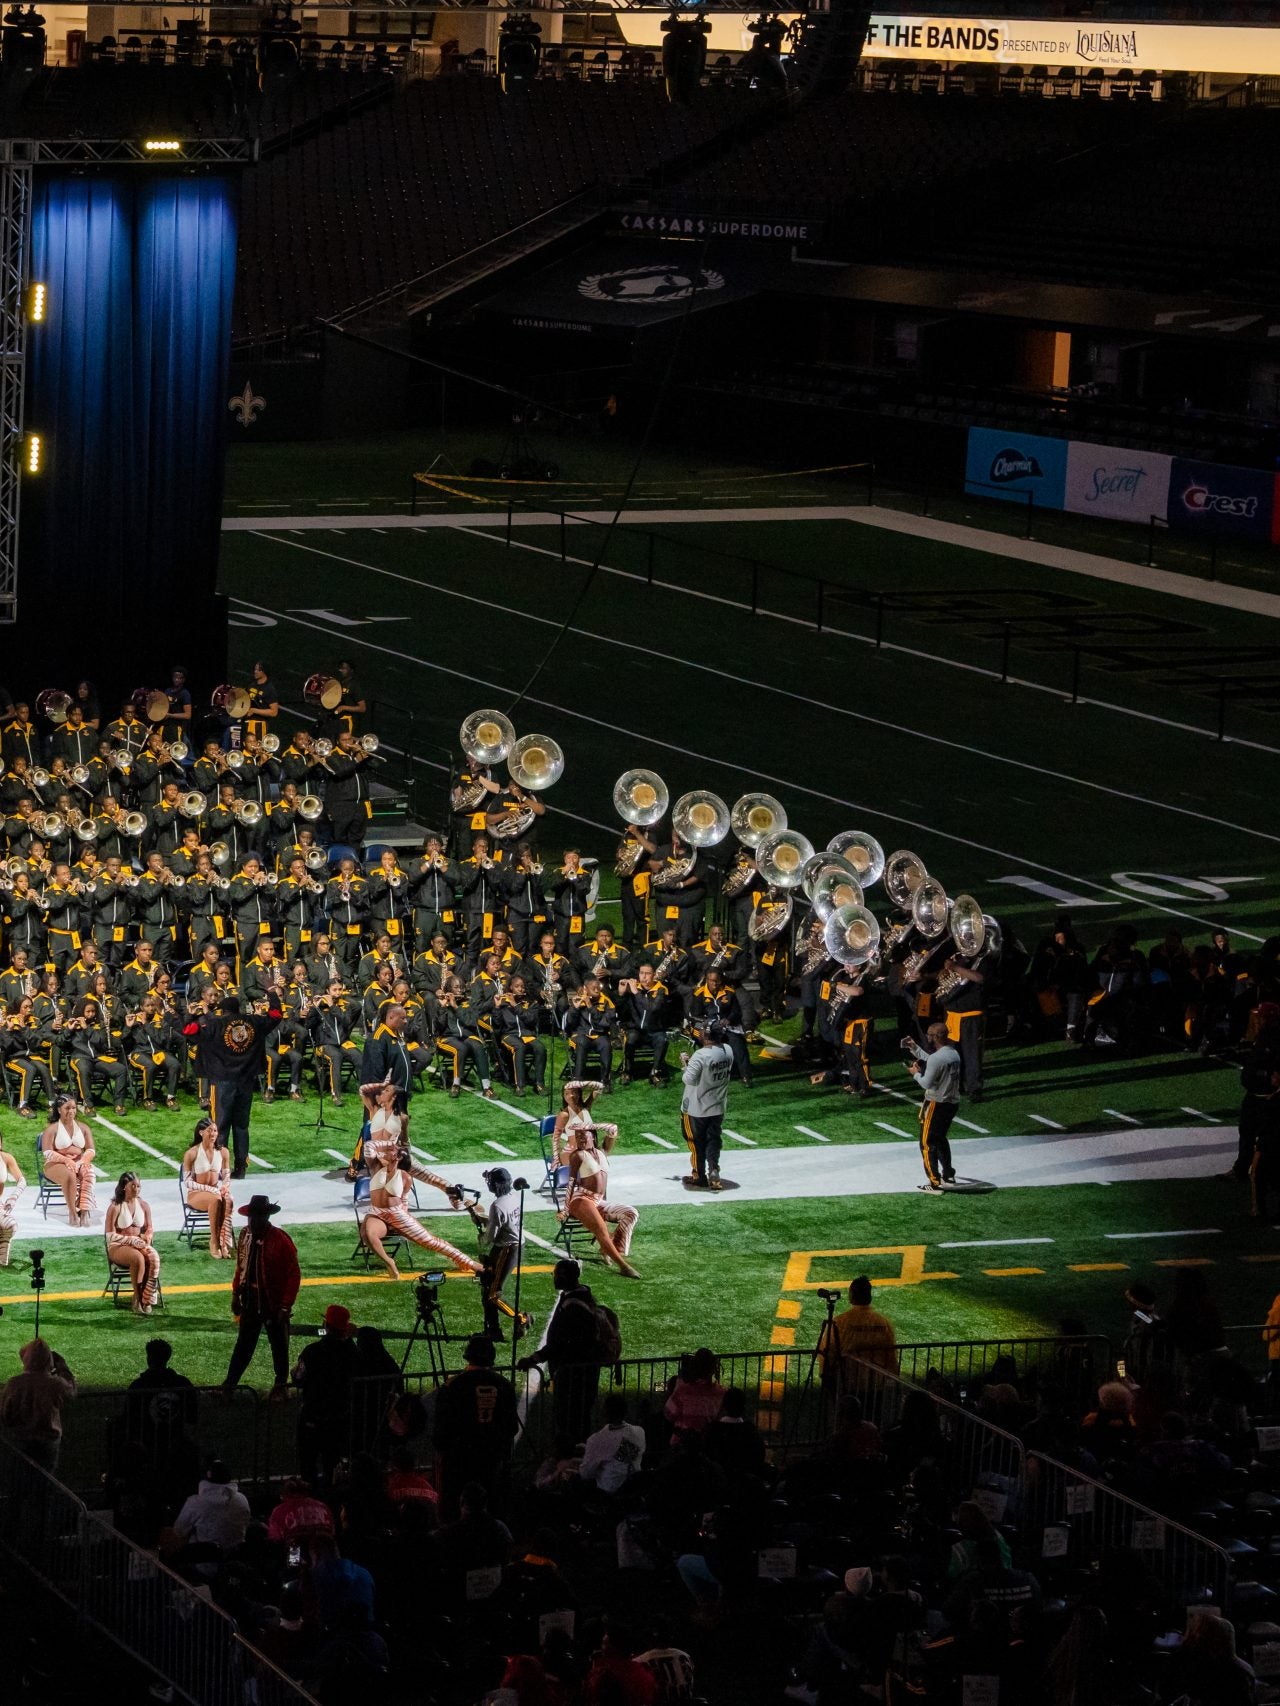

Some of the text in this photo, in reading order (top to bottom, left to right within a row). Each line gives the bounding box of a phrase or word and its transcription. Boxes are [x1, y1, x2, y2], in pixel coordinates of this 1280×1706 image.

[883, 25, 922, 48] THE
[927, 27, 999, 51] BANDS
[1002, 40, 1071, 53] PRESENTED BY
[621, 215, 705, 234] CAESARS
[993, 457, 1033, 477] Charmin
[1084, 467, 1148, 501] Secret
[1183, 485, 1258, 518] Crest
